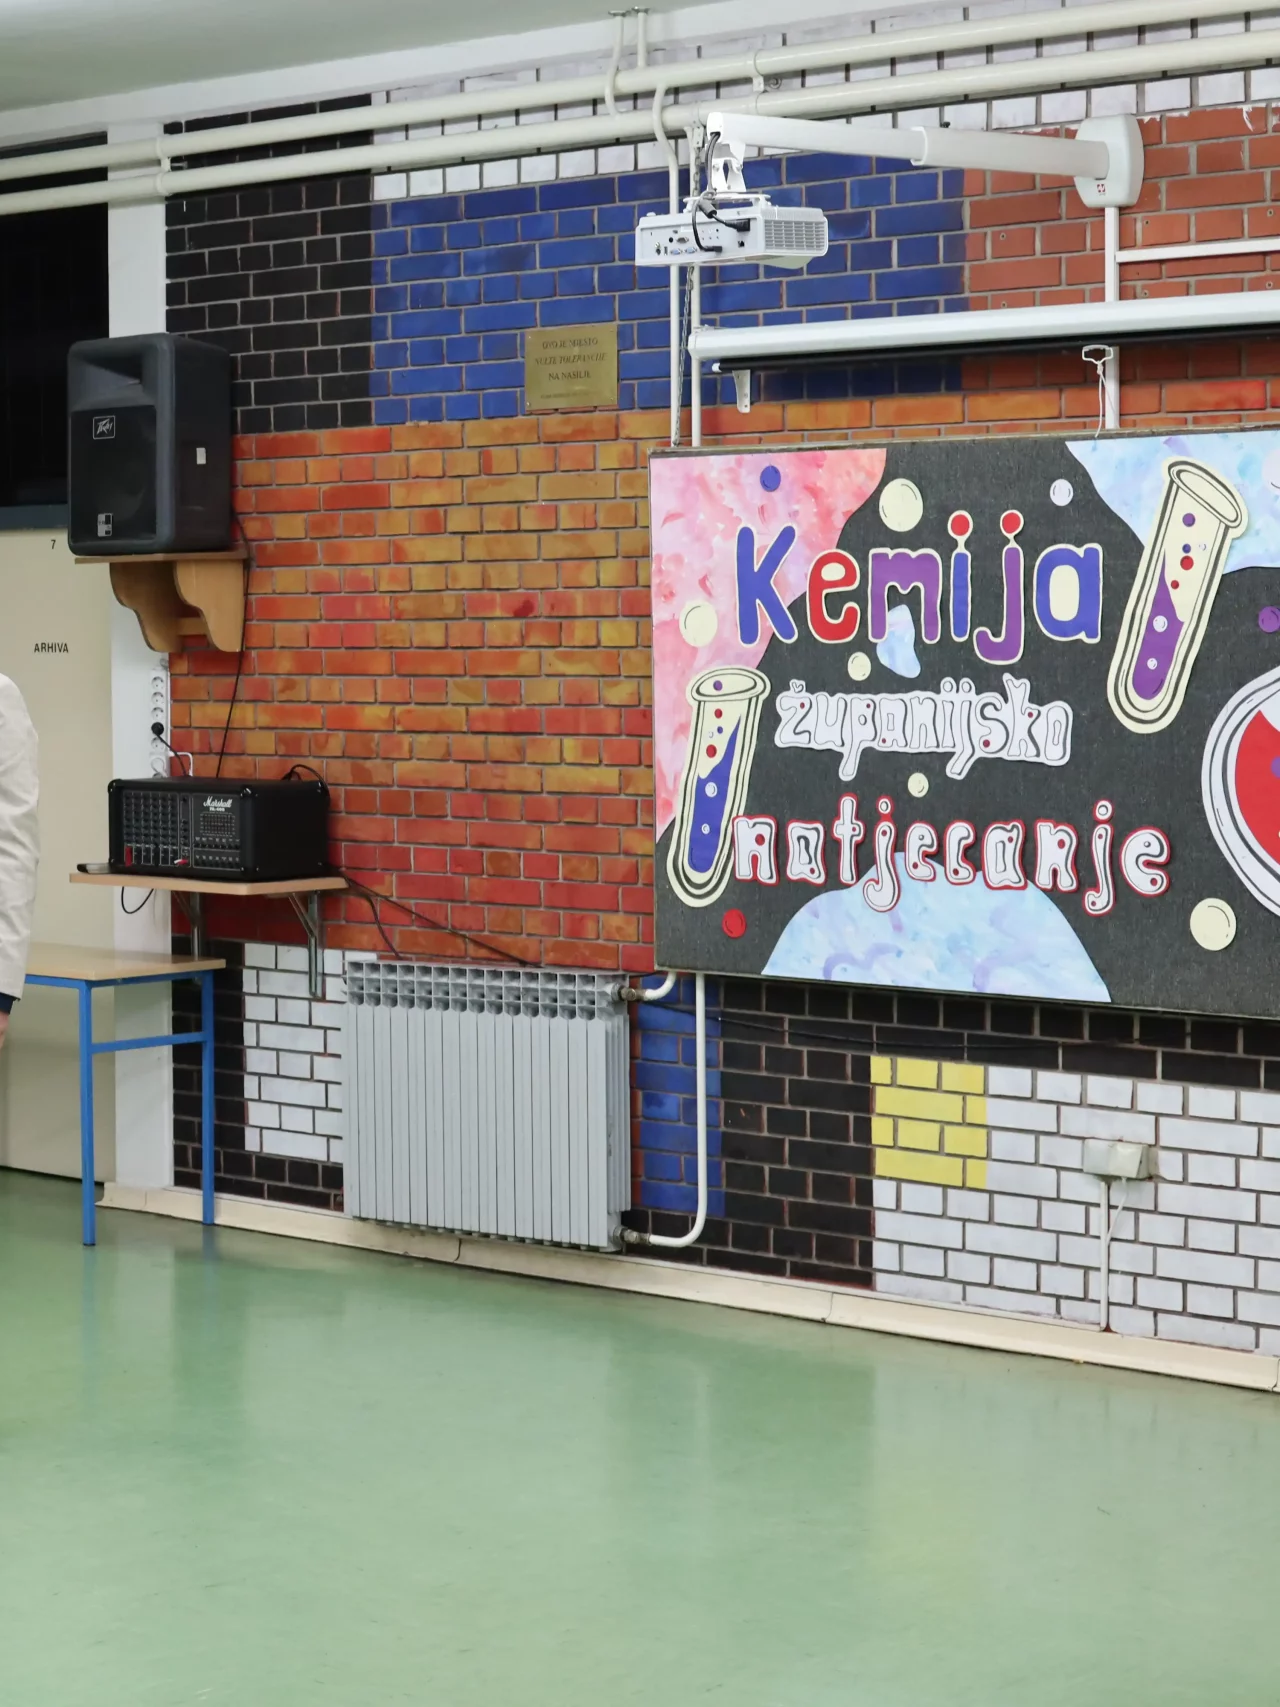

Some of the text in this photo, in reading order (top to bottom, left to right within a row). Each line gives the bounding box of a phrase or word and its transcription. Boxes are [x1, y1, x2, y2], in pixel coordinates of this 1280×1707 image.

[51, 539, 56, 550] 7
[734, 510, 1103, 665] Kemija
[34, 642, 69, 653] ARHIVA
[203, 796, 233, 808] Marshall
[732, 793, 1171, 916] natjecanje
